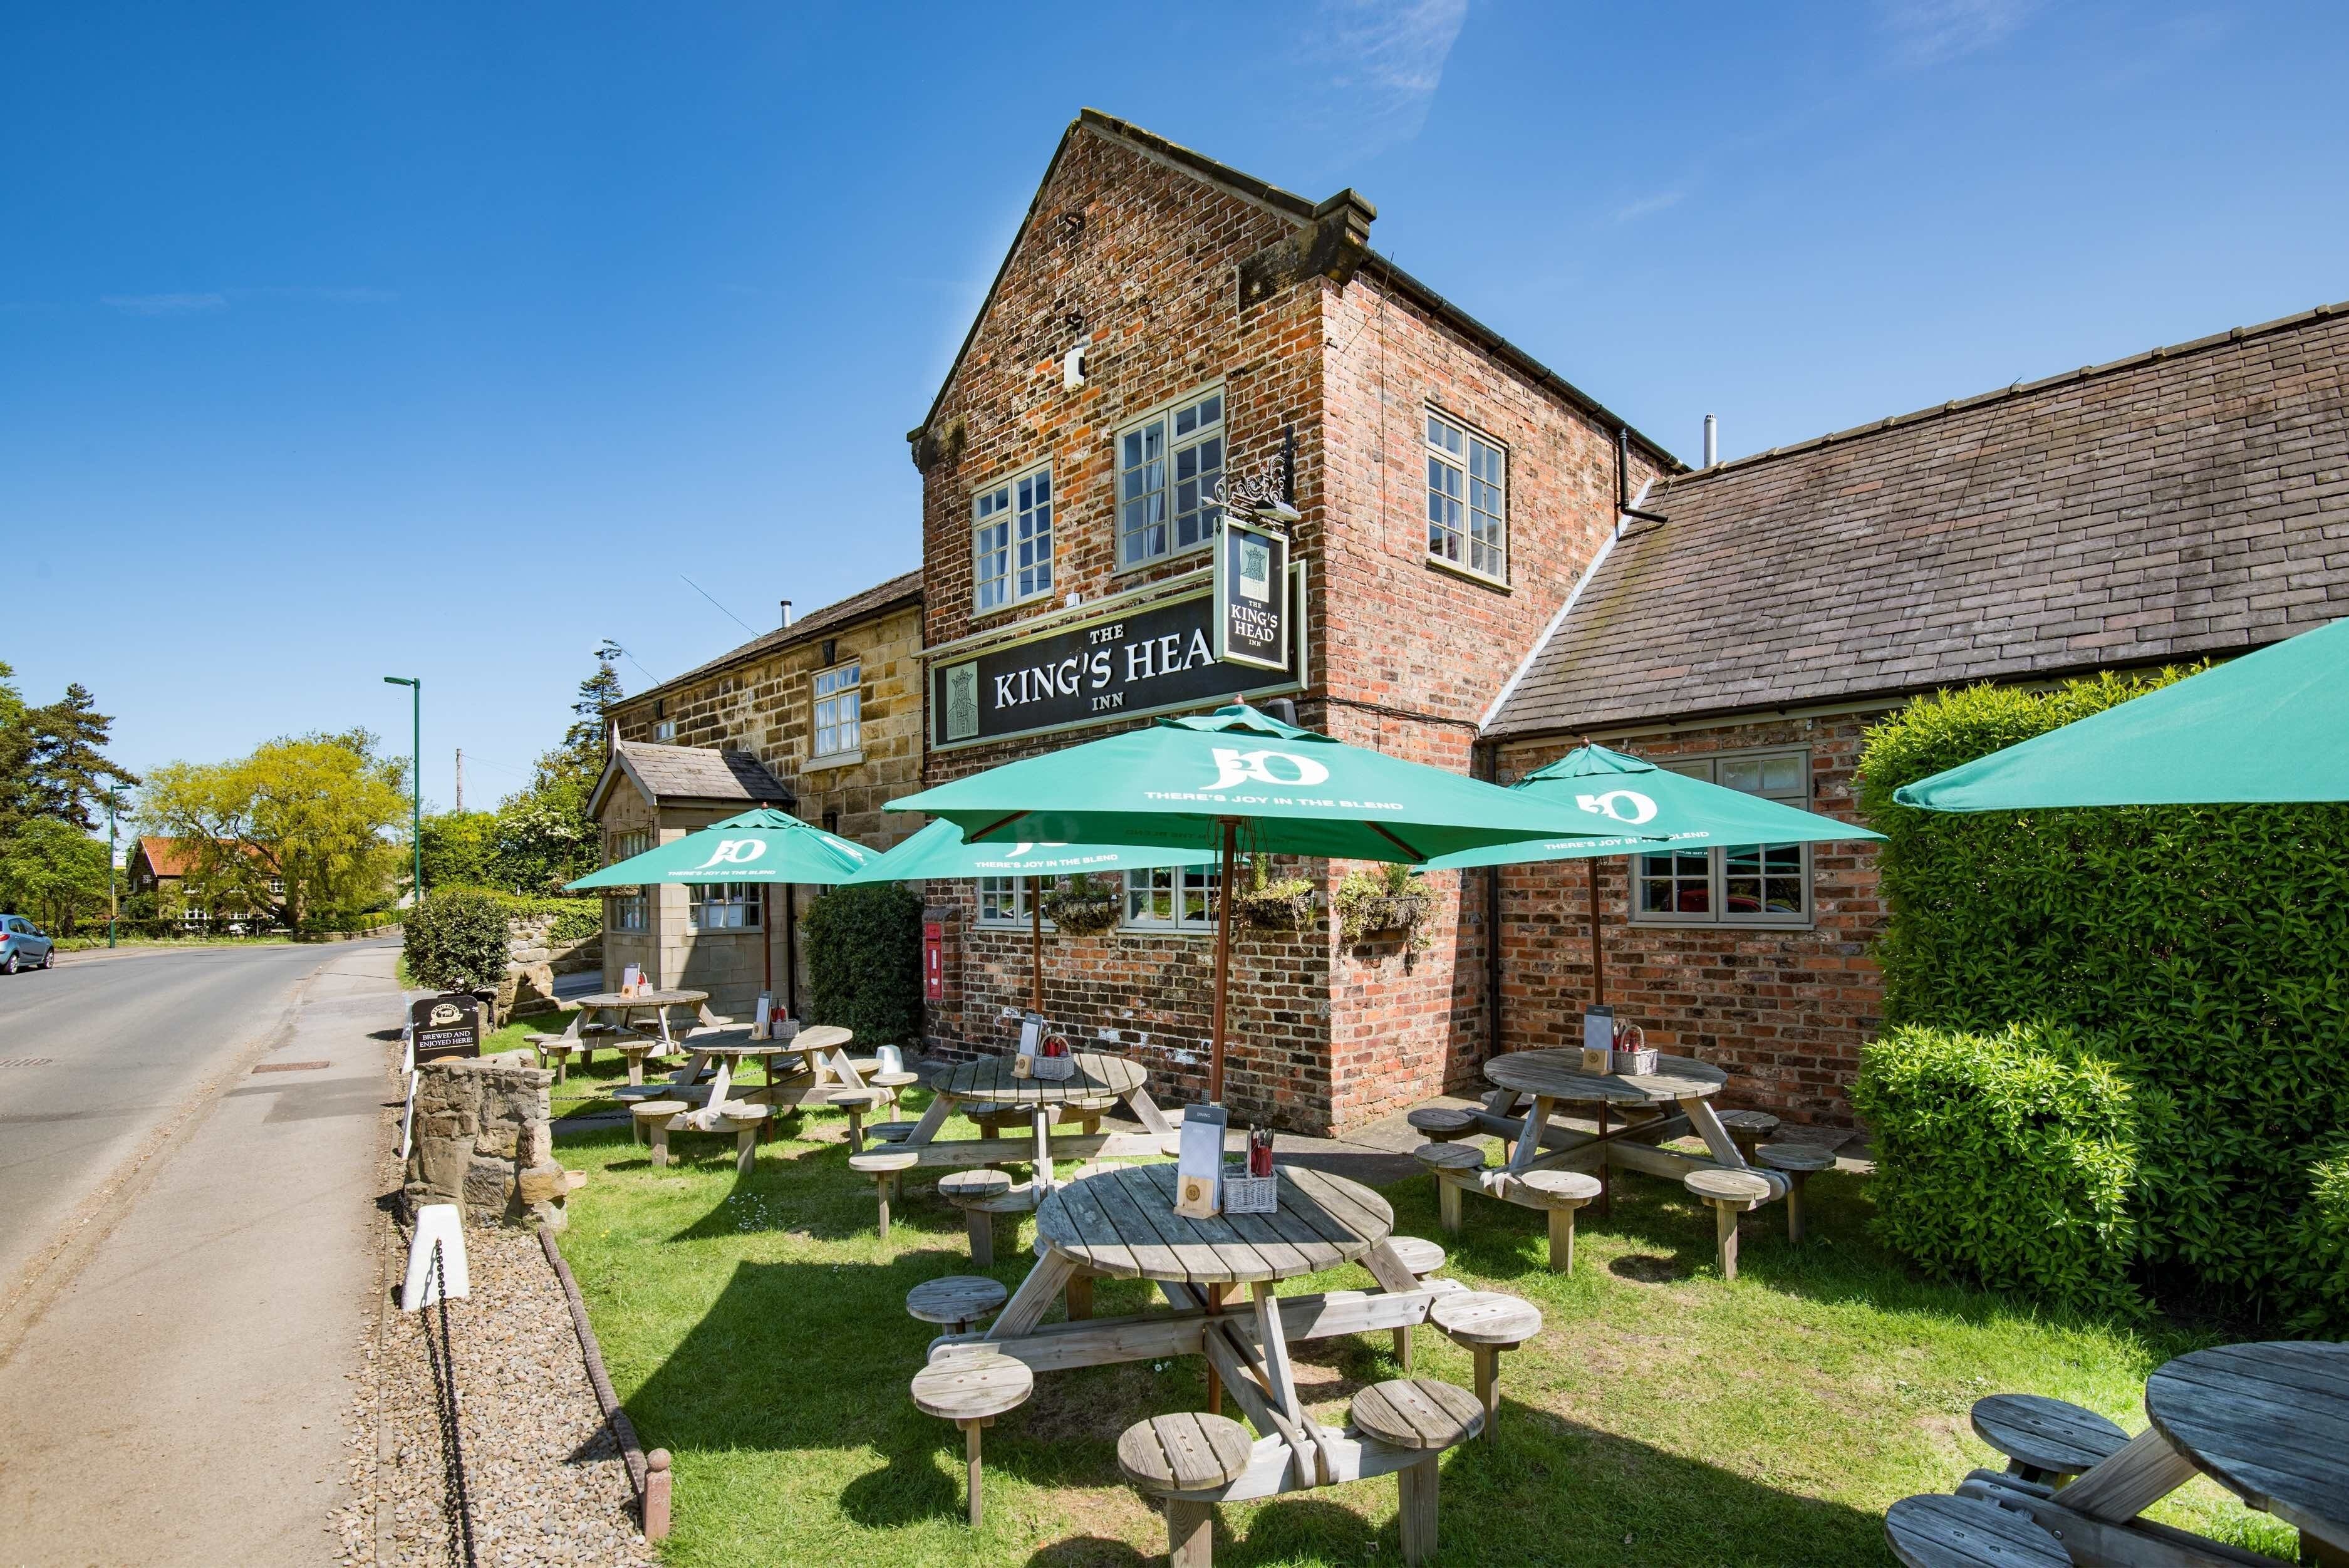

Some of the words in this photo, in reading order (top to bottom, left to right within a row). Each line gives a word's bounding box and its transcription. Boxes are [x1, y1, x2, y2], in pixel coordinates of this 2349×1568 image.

[1248, 600, 1262, 609] THE
[1231, 604, 1278, 629] KING'S
[1090, 623, 1124, 645] THE
[1235, 620, 1274, 642] HEAD
[994, 648, 1112, 709] KING'S
[1124, 628, 1223, 682] HEA
[1092, 692, 1124, 712] INN
[1144, 791, 1226, 802] THERE'S
[1273, 797, 1294, 805] IN
[1296, 799, 1336, 807] THE
[1339, 800, 1404, 810] BLEND
[1543, 841, 1595, 850] THERE'S
[1082, 854, 1118, 864] BLEND
[420, 1039, 451, 1047] ENJOYED
